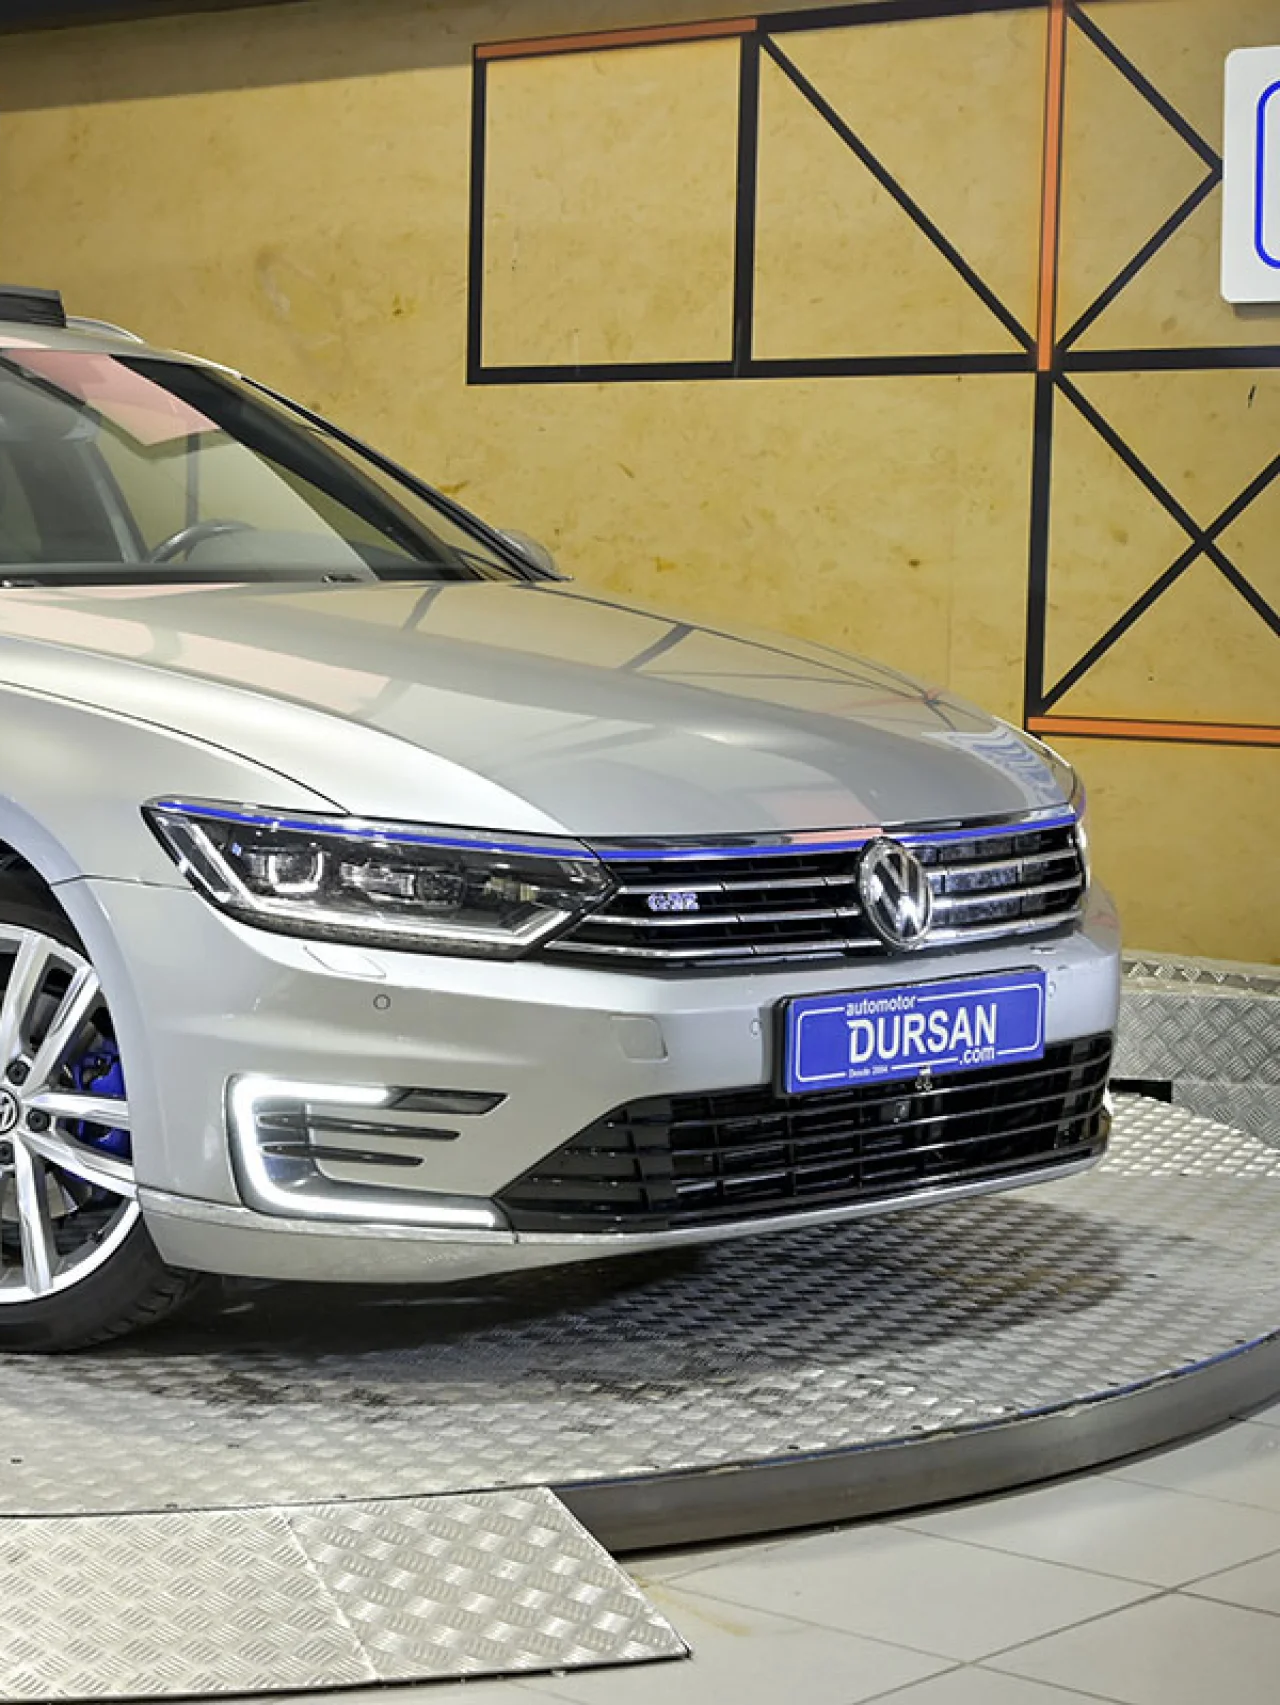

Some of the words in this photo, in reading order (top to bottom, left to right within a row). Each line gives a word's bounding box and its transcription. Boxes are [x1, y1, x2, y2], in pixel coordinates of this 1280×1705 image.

[846, 994, 917, 1017] automotor
[847, 1003, 997, 1064] DURSAN
[959, 1046, 995, 1065] .com
